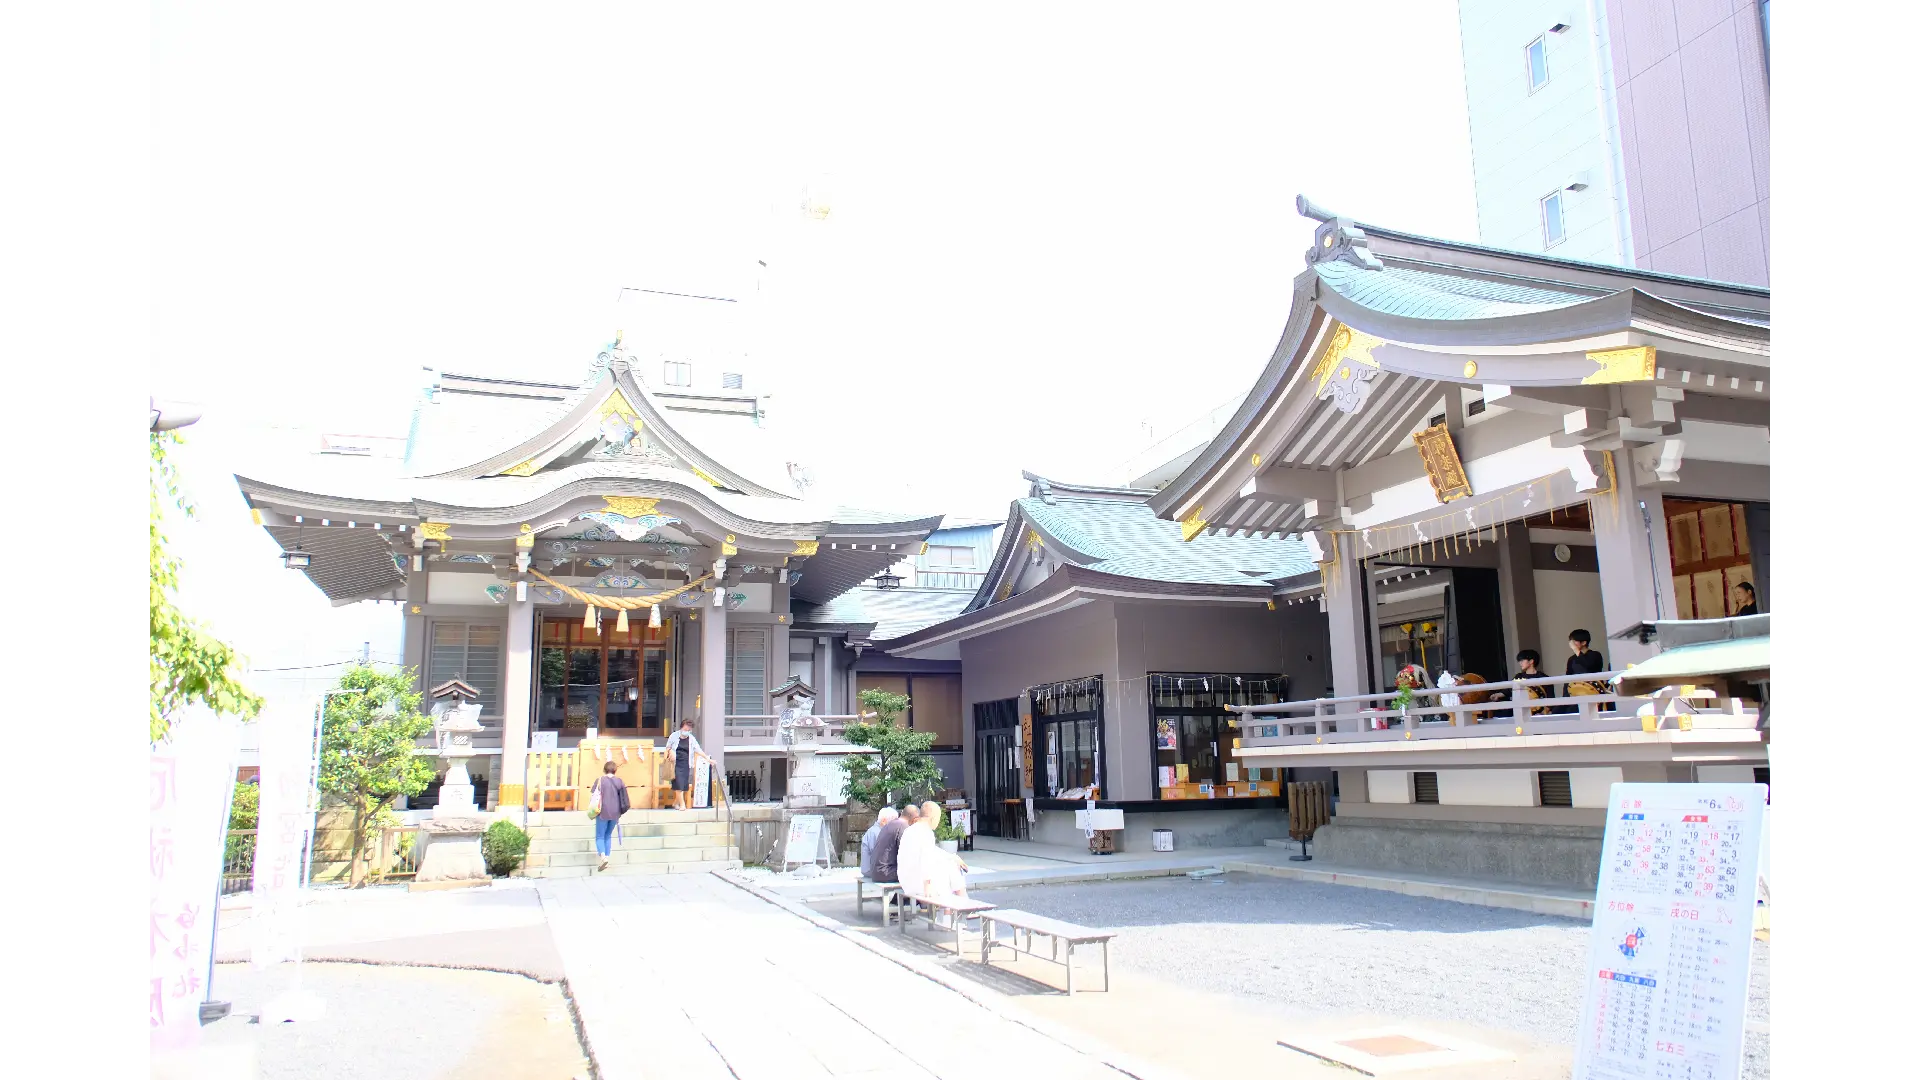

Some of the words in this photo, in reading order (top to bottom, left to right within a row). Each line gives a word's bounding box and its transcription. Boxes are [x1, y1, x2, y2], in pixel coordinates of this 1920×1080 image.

[1670, 908, 1699, 920] 戌の日
[1656, 1040, 1685, 1056] 七五三
